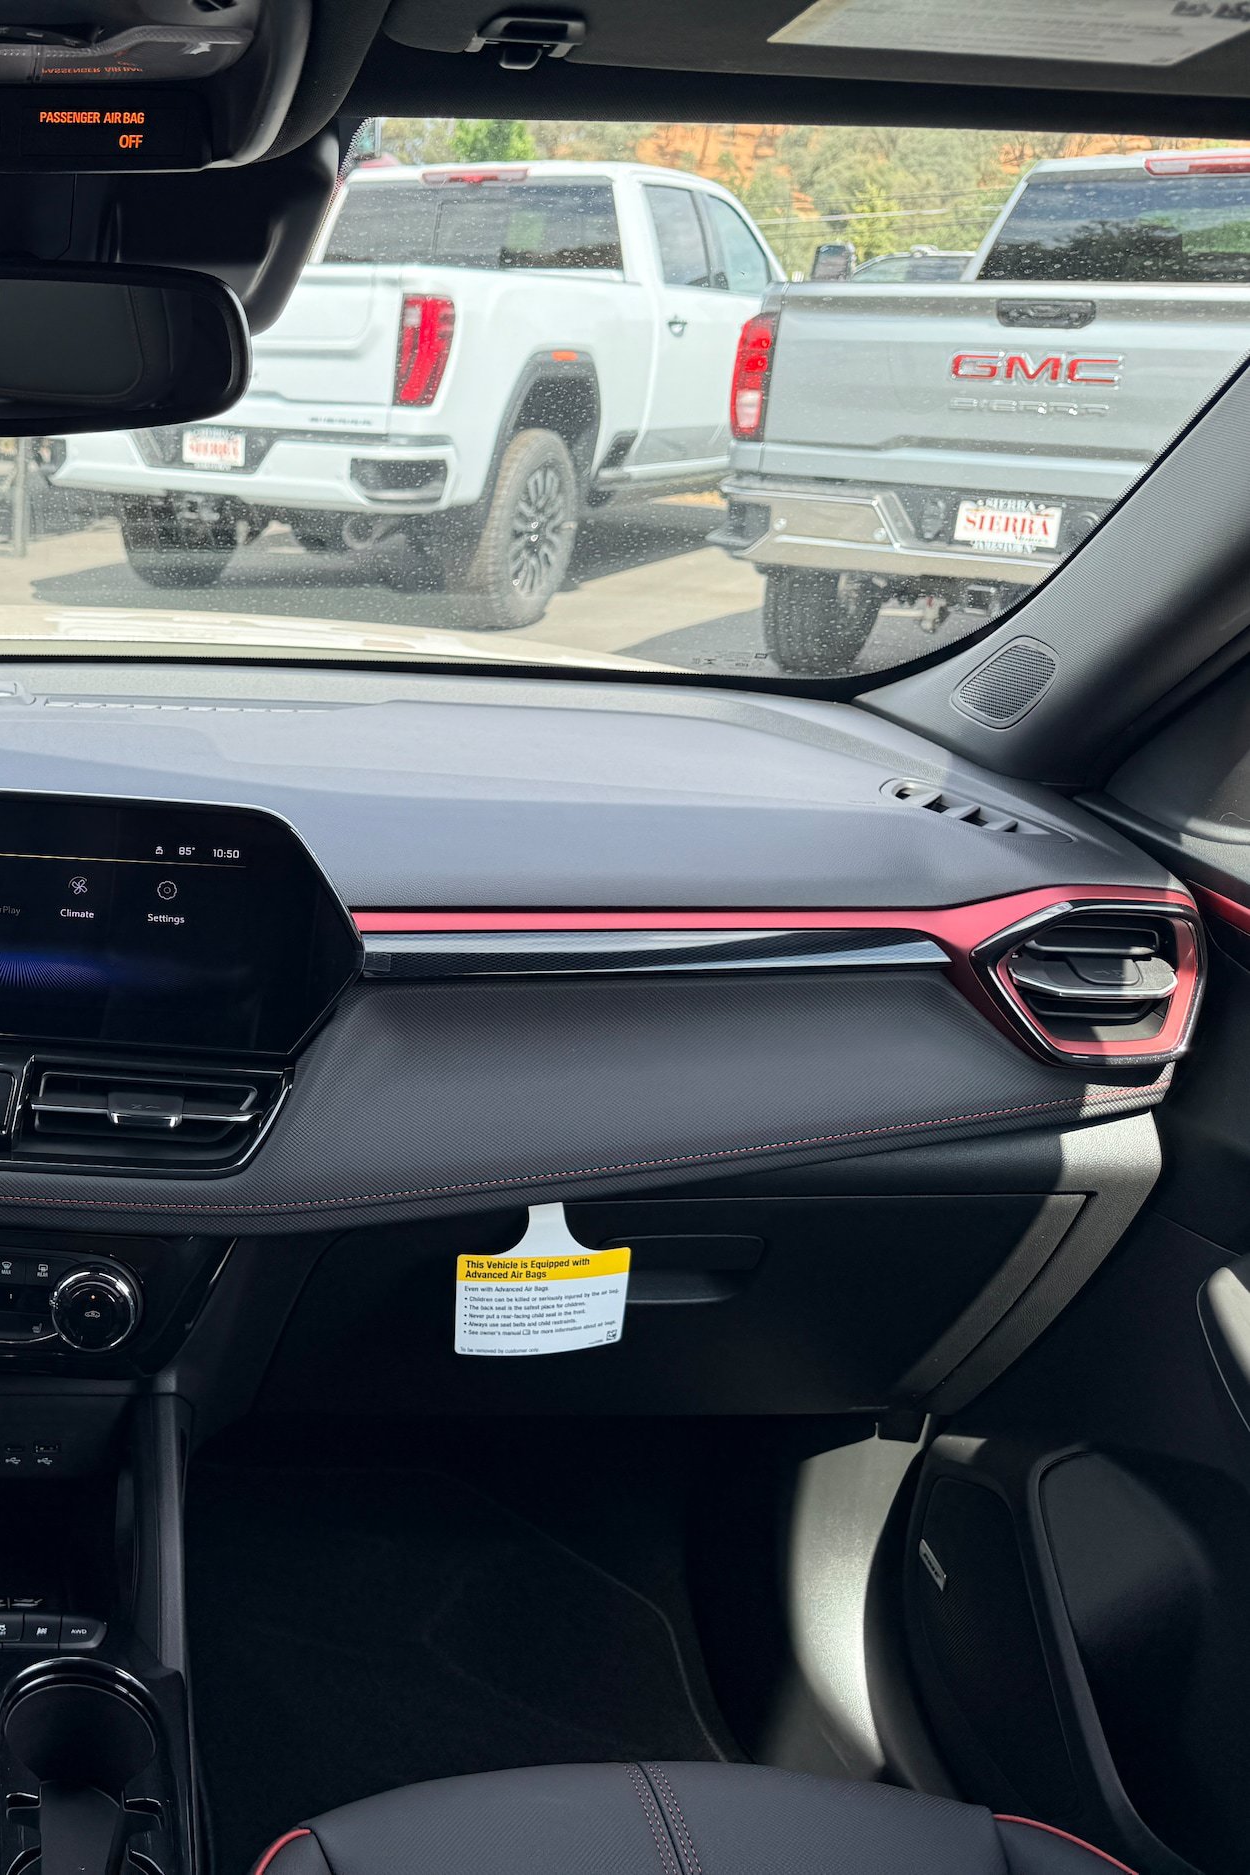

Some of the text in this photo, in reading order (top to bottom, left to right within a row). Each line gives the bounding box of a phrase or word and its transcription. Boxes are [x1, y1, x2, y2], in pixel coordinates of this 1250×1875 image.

[39, 111, 145, 125] PASSENGER AIR BAG
[118, 134, 143, 149] OFF
[951, 351, 1124, 389] GMC
[963, 514, 1049, 536] SIERRA
[212, 848, 240, 859] 10:50
[60, 908, 95, 919] Climate
[147, 913, 185, 926] Settings
[466, 1258, 590, 1269] This Vehicle is Equipped with
[465, 1271, 547, 1279] Advanced Air Bags
[70, 1628, 88, 1636] AWD
